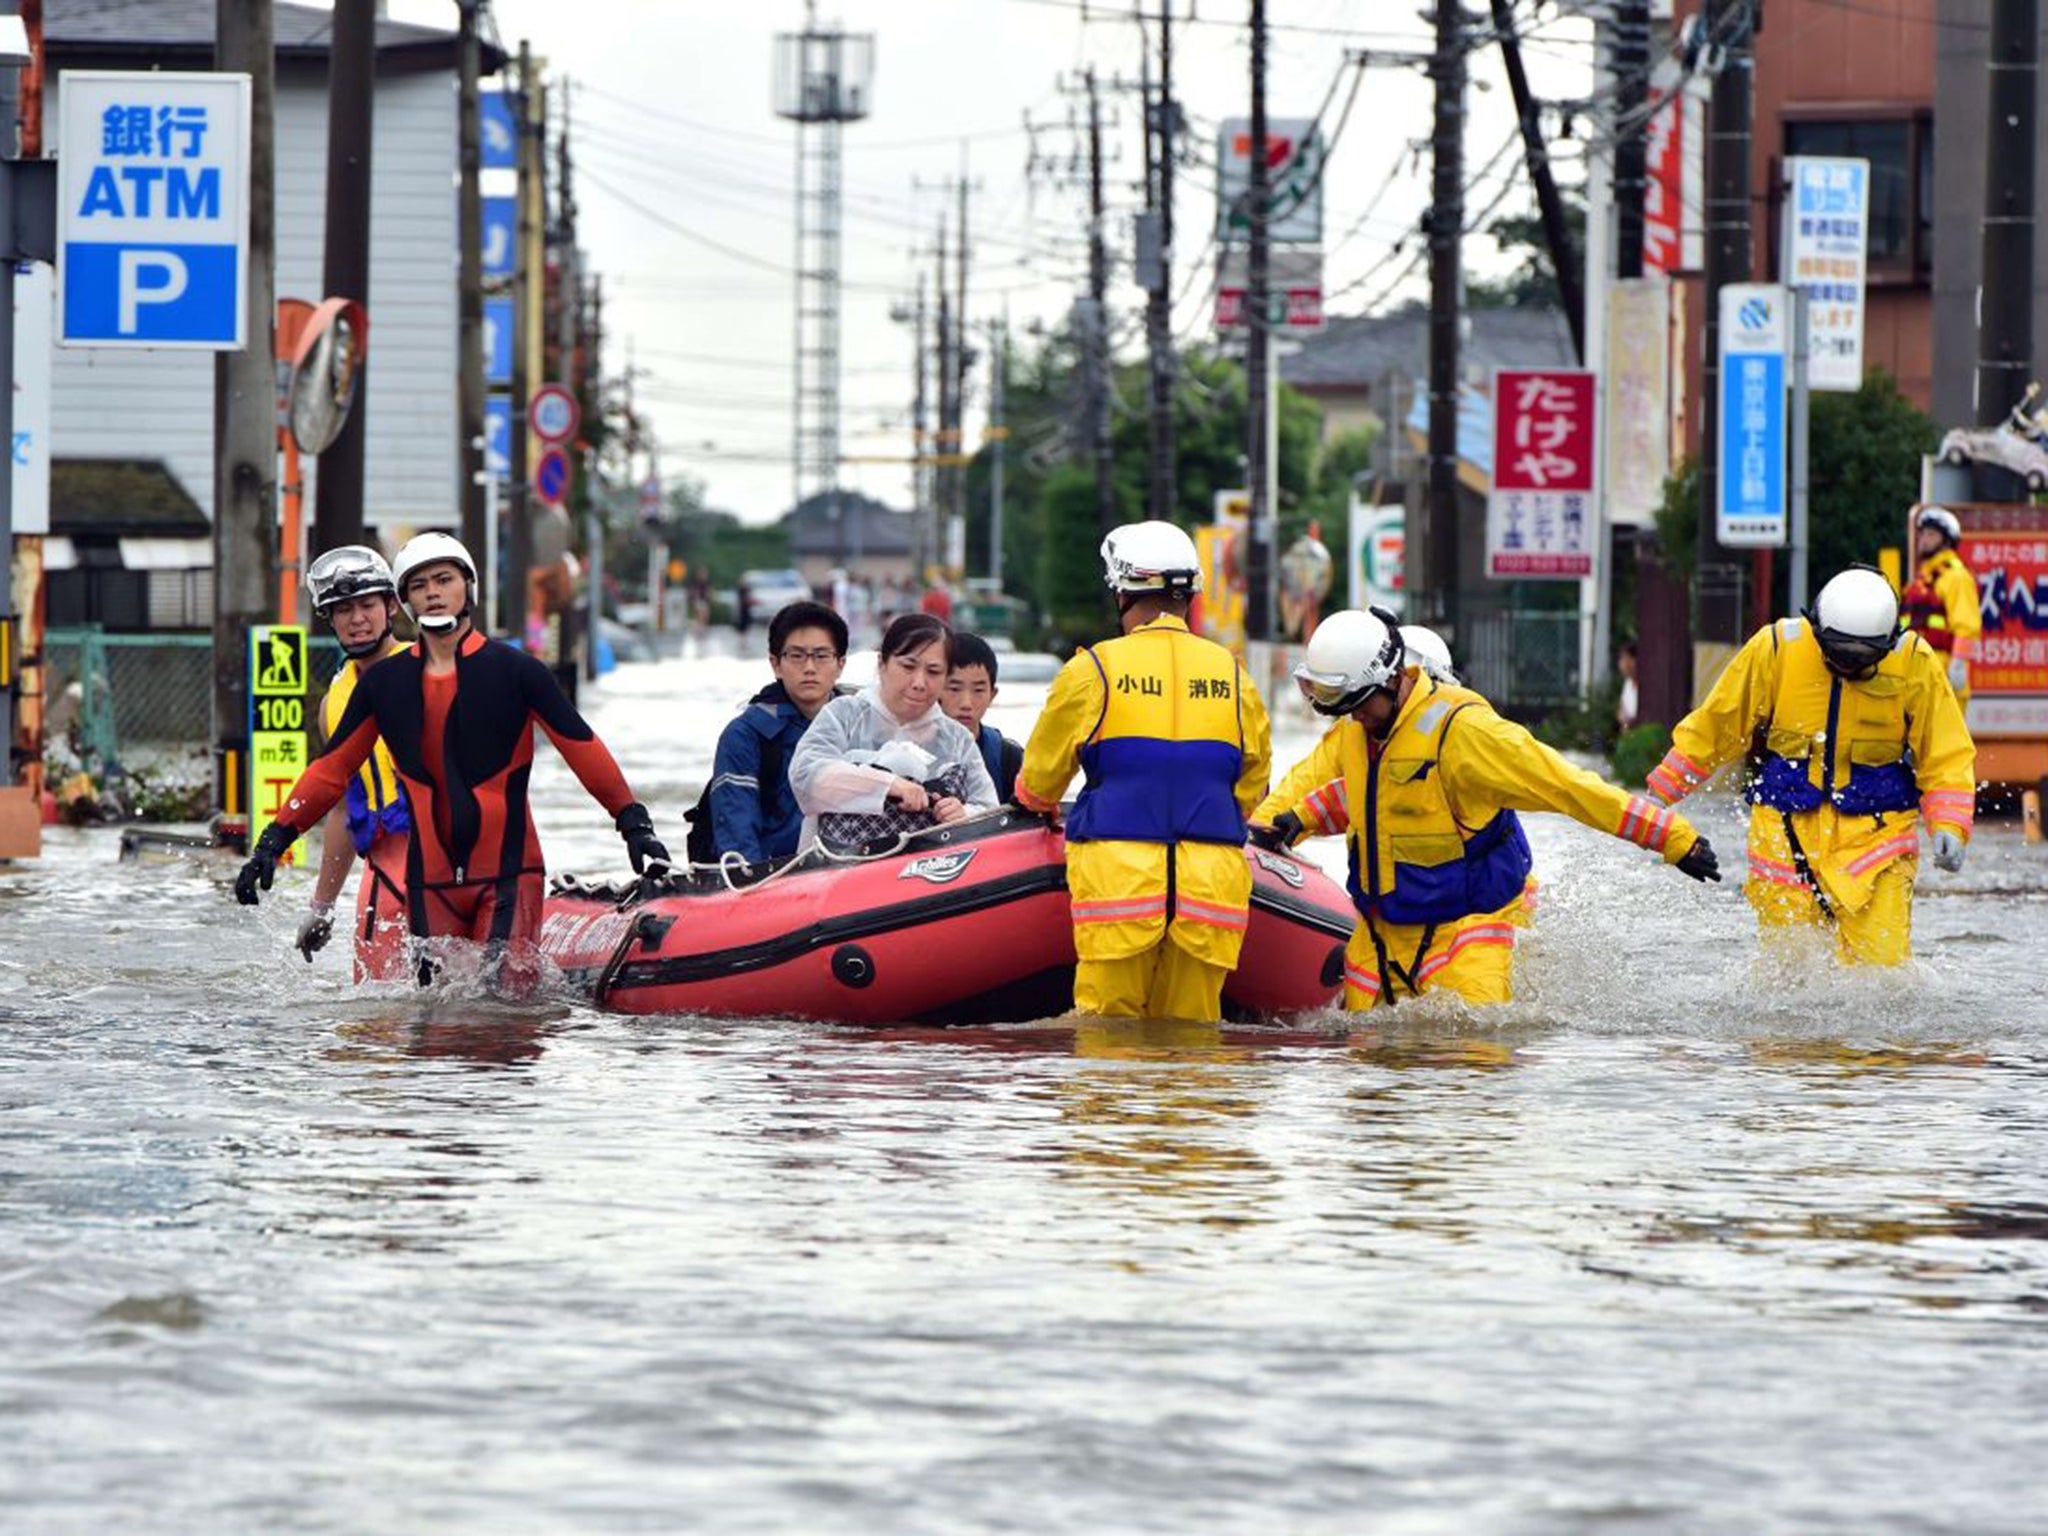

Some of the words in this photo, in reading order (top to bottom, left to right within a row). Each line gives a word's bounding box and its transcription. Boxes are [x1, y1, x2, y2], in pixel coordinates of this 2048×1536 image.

[102, 104, 208, 157] 銀行
[78, 166, 221, 219] ATM
[118, 250, 189, 334] P
[1513, 377, 1578, 486] たけや
[1117, 674, 1162, 696] 小山
[1189, 679, 1231, 699] 消防
[259, 699, 303, 729] 100
